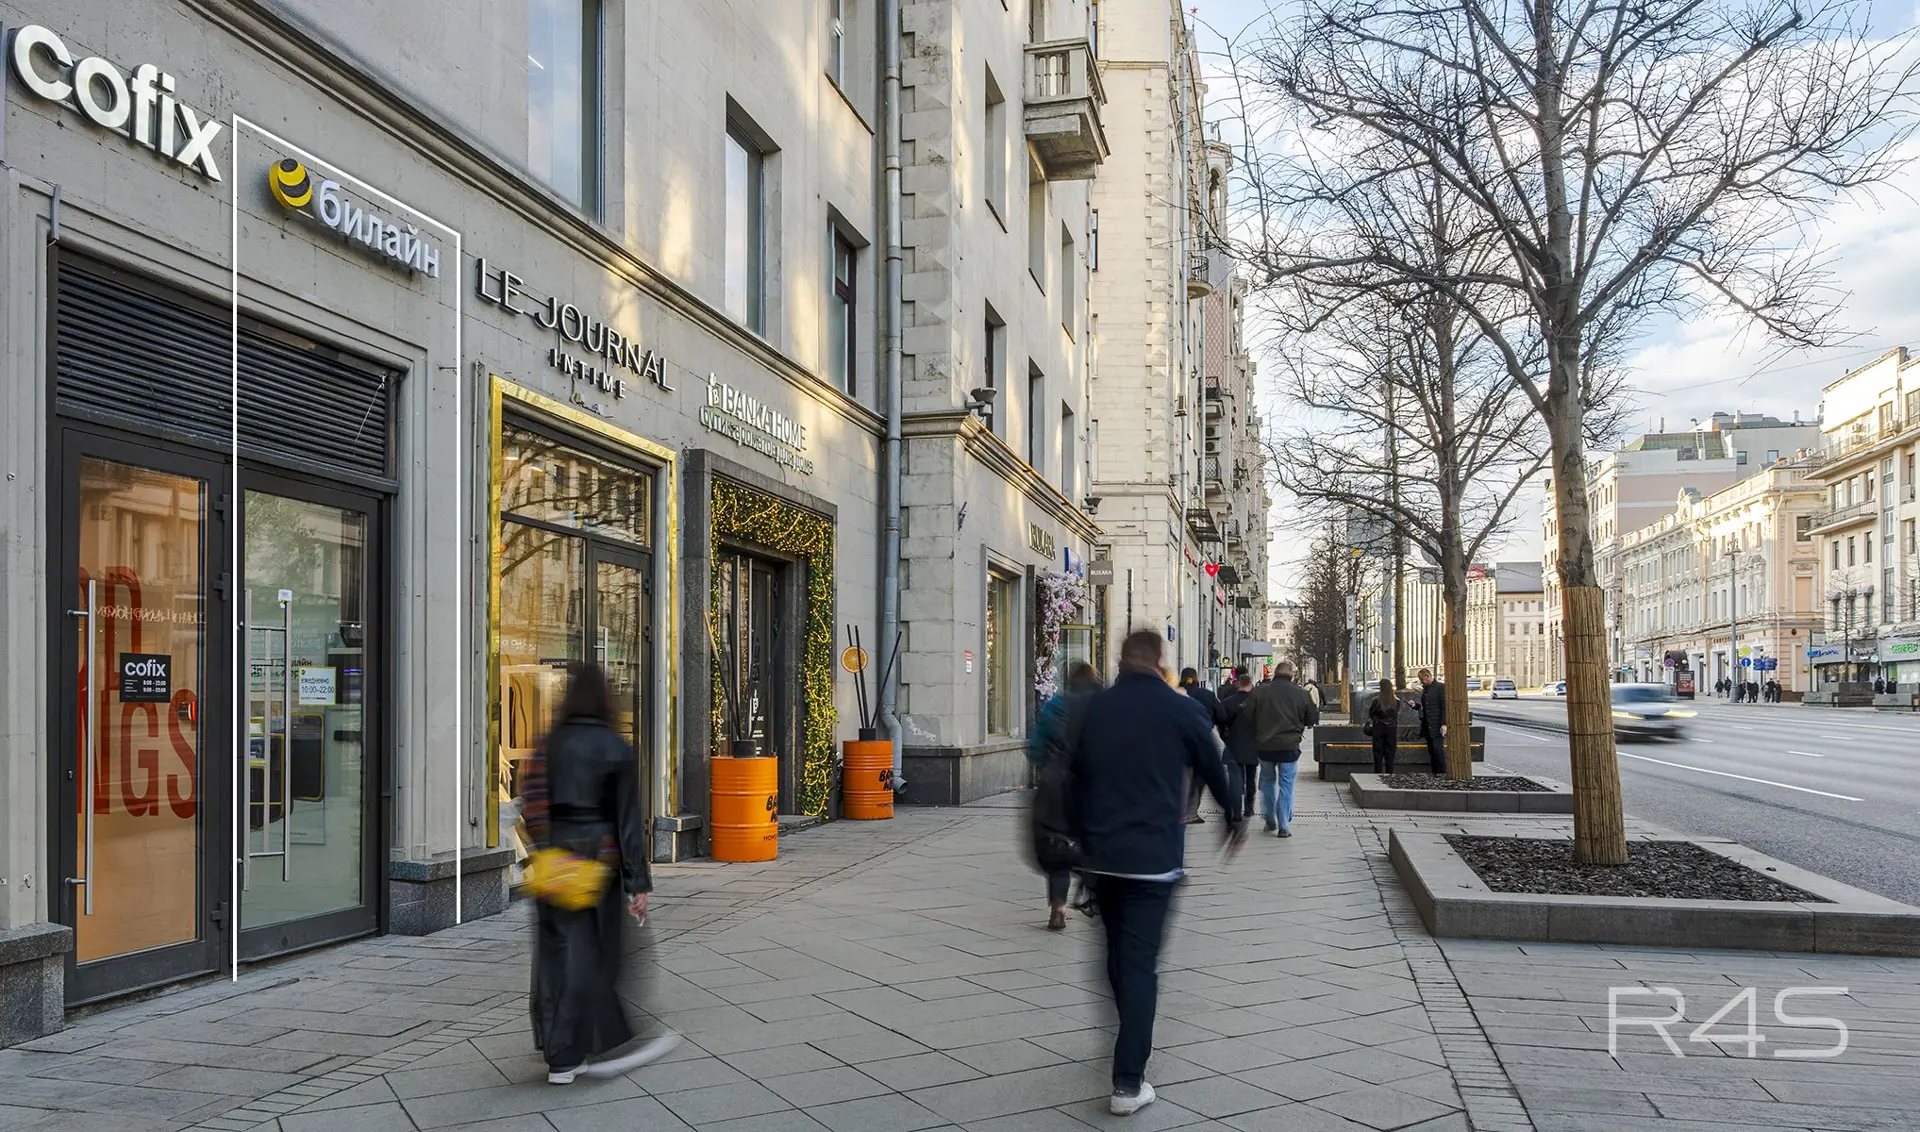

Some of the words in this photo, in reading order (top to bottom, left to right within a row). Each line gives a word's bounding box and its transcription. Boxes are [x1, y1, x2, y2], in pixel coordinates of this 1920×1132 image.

[8, 25, 222, 182] cofix
[315, 180, 439, 278] билайн
[477, 258, 524, 314] LE
[534, 297, 676, 392] JOURNAL
[549, 348, 626, 399] INTIME
[699, 404, 733, 437] бутик
[722, 383, 772, 435] BANKA
[772, 410, 807, 452] HOME
[124, 658, 166, 677] cofix
